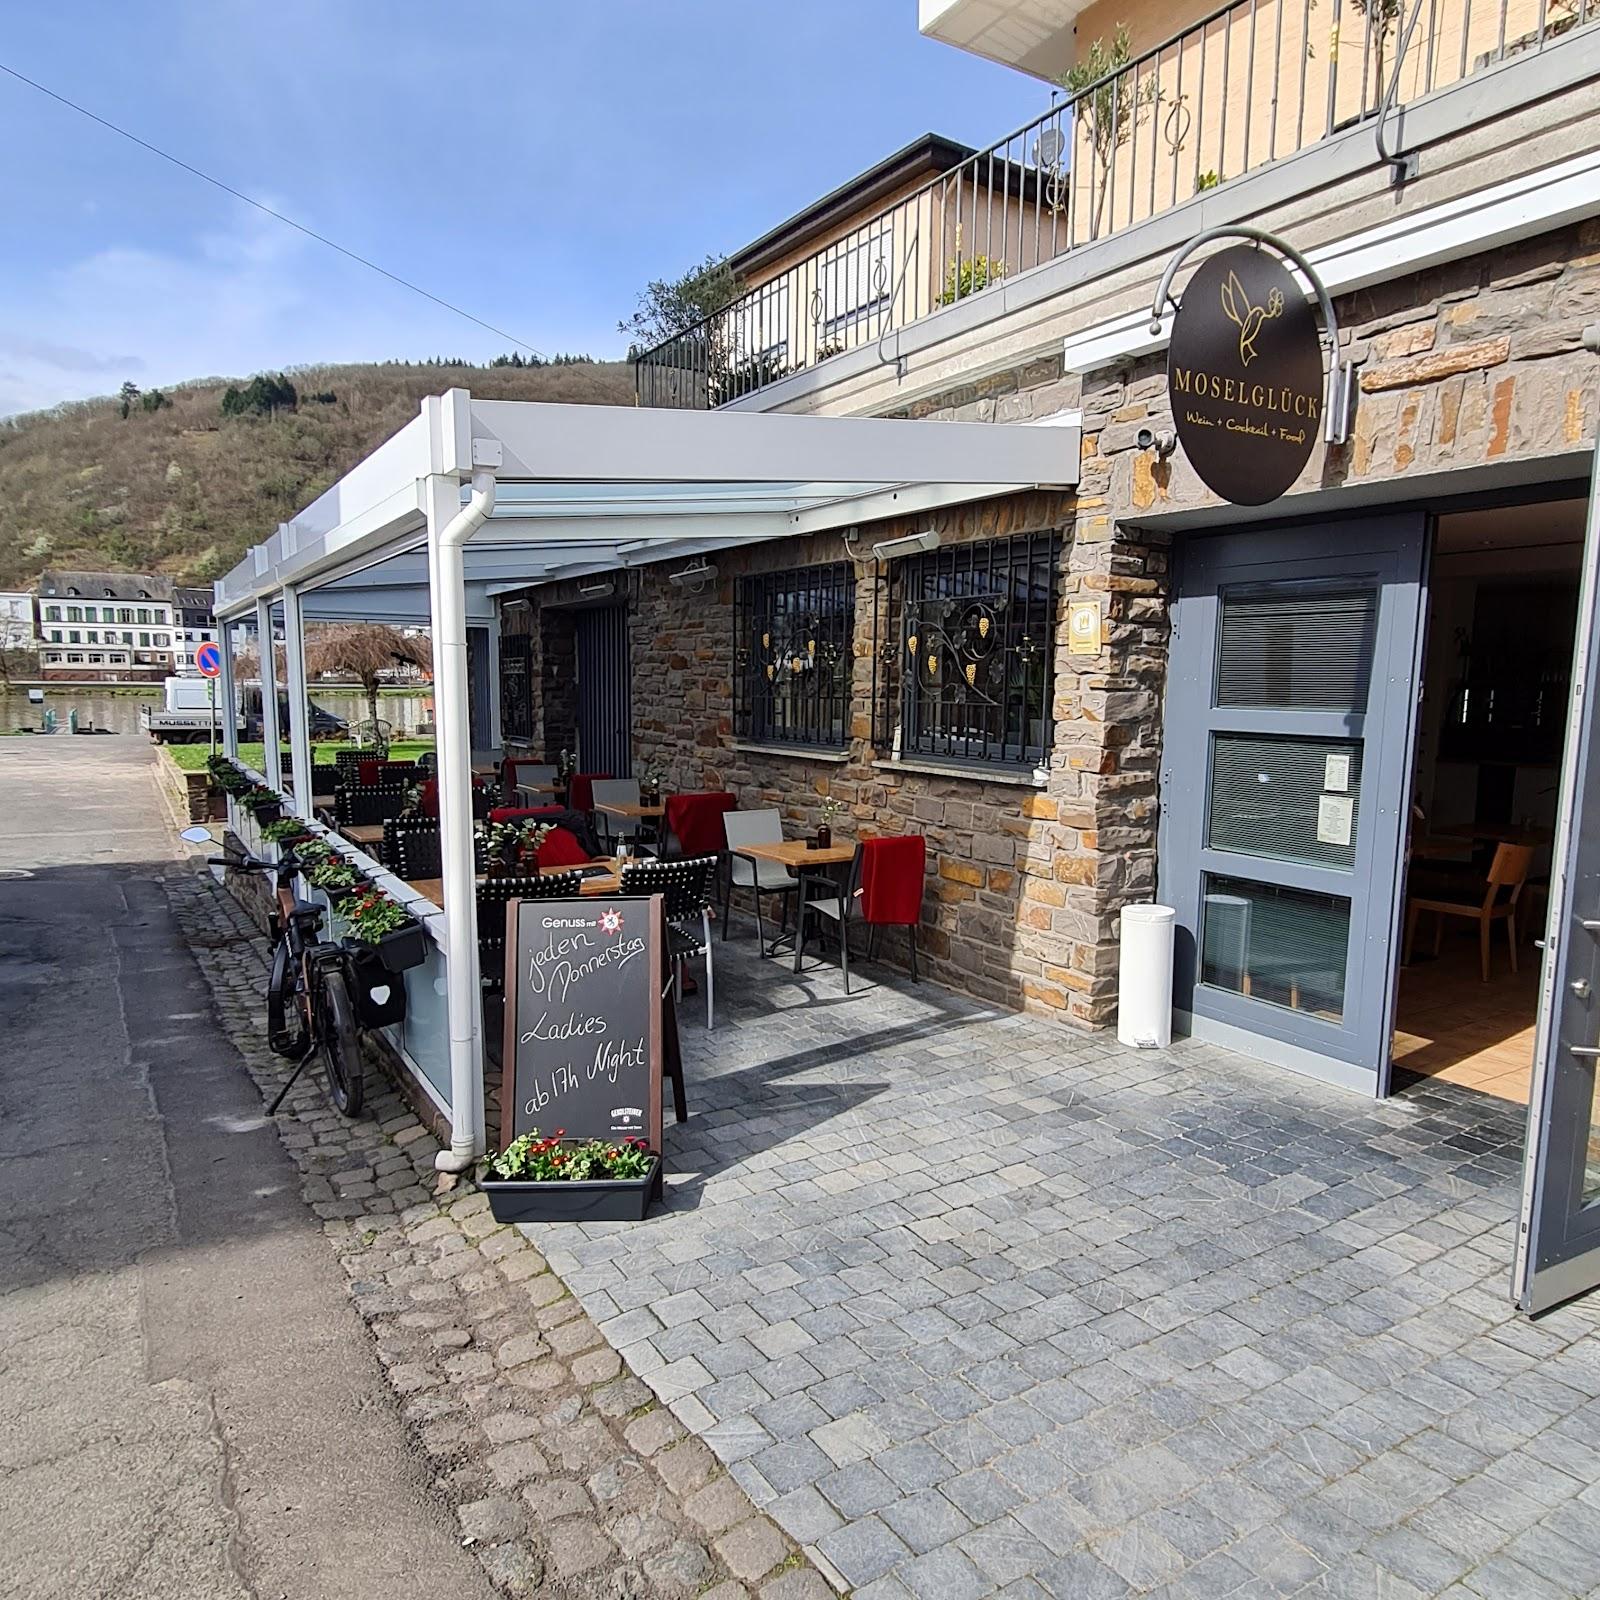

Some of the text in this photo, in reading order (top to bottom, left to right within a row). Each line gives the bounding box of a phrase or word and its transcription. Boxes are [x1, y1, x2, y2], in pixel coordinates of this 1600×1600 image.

[1174, 367, 1319, 419] MOSELGLÜCK
[1186, 410, 1215, 427] Wein
[1225, 418, 1269, 437] Cocktail
[1279, 427, 1306, 445] Food
[541, 917, 586, 928] Genuss
[528, 932, 595, 994] jeden
[547, 933, 646, 1003] Donnerstag
[520, 1011, 607, 1044] Ladies
[586, 1037, 646, 1084] Night
